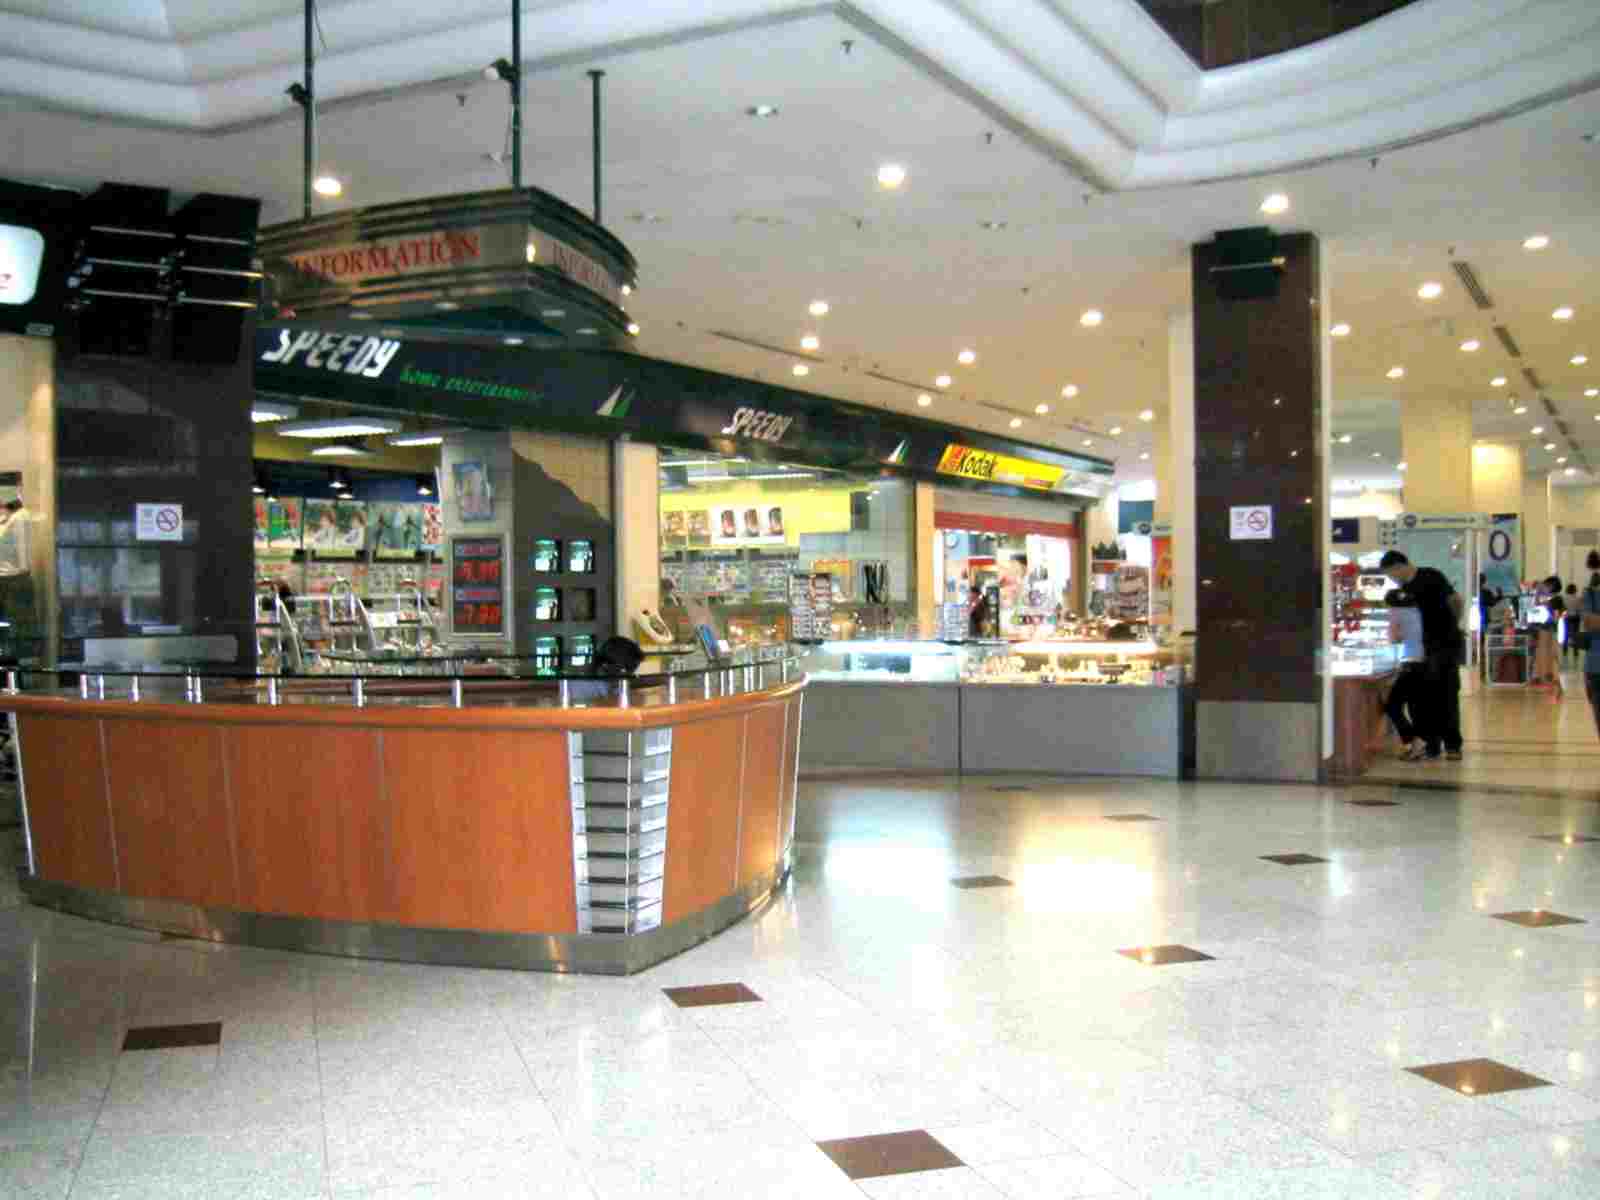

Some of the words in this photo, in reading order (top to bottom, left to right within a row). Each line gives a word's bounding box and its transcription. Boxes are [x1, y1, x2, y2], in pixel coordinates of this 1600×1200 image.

[290, 231, 481, 274] INFORMATION
[262, 329, 400, 378] SPEEDY
[721, 407, 793, 443] SPEEDY
[959, 449, 999, 477] Kodak
